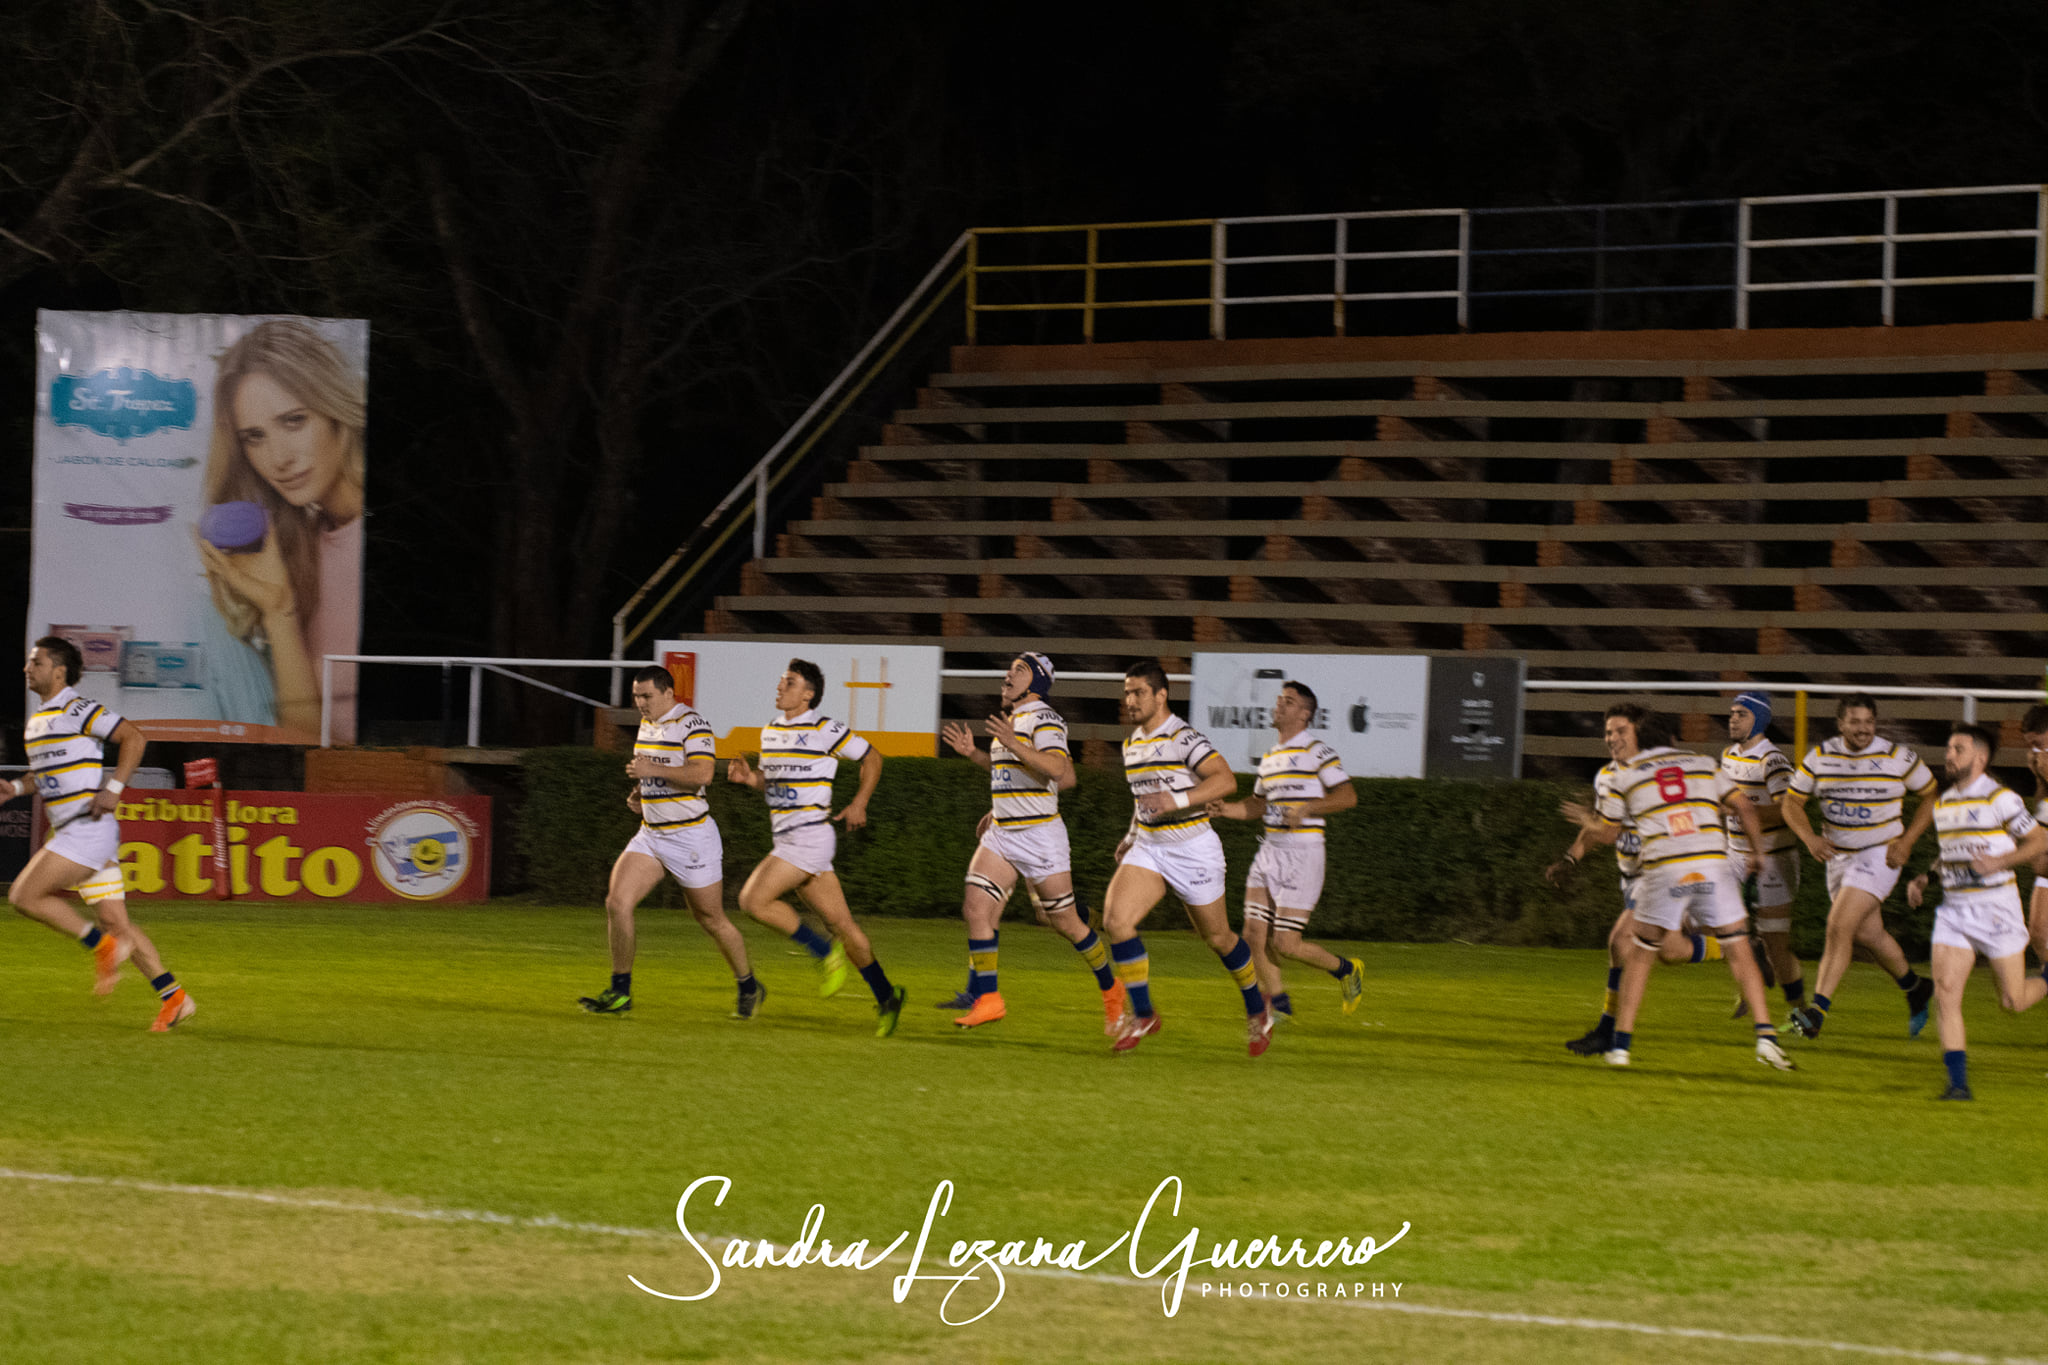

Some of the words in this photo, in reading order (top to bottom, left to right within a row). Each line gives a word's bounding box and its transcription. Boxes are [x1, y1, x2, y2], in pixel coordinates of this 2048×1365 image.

[1208, 706, 1265, 729] WAKE
[1655, 765, 1687, 804] 8
[1827, 800, 1872, 819] Club
